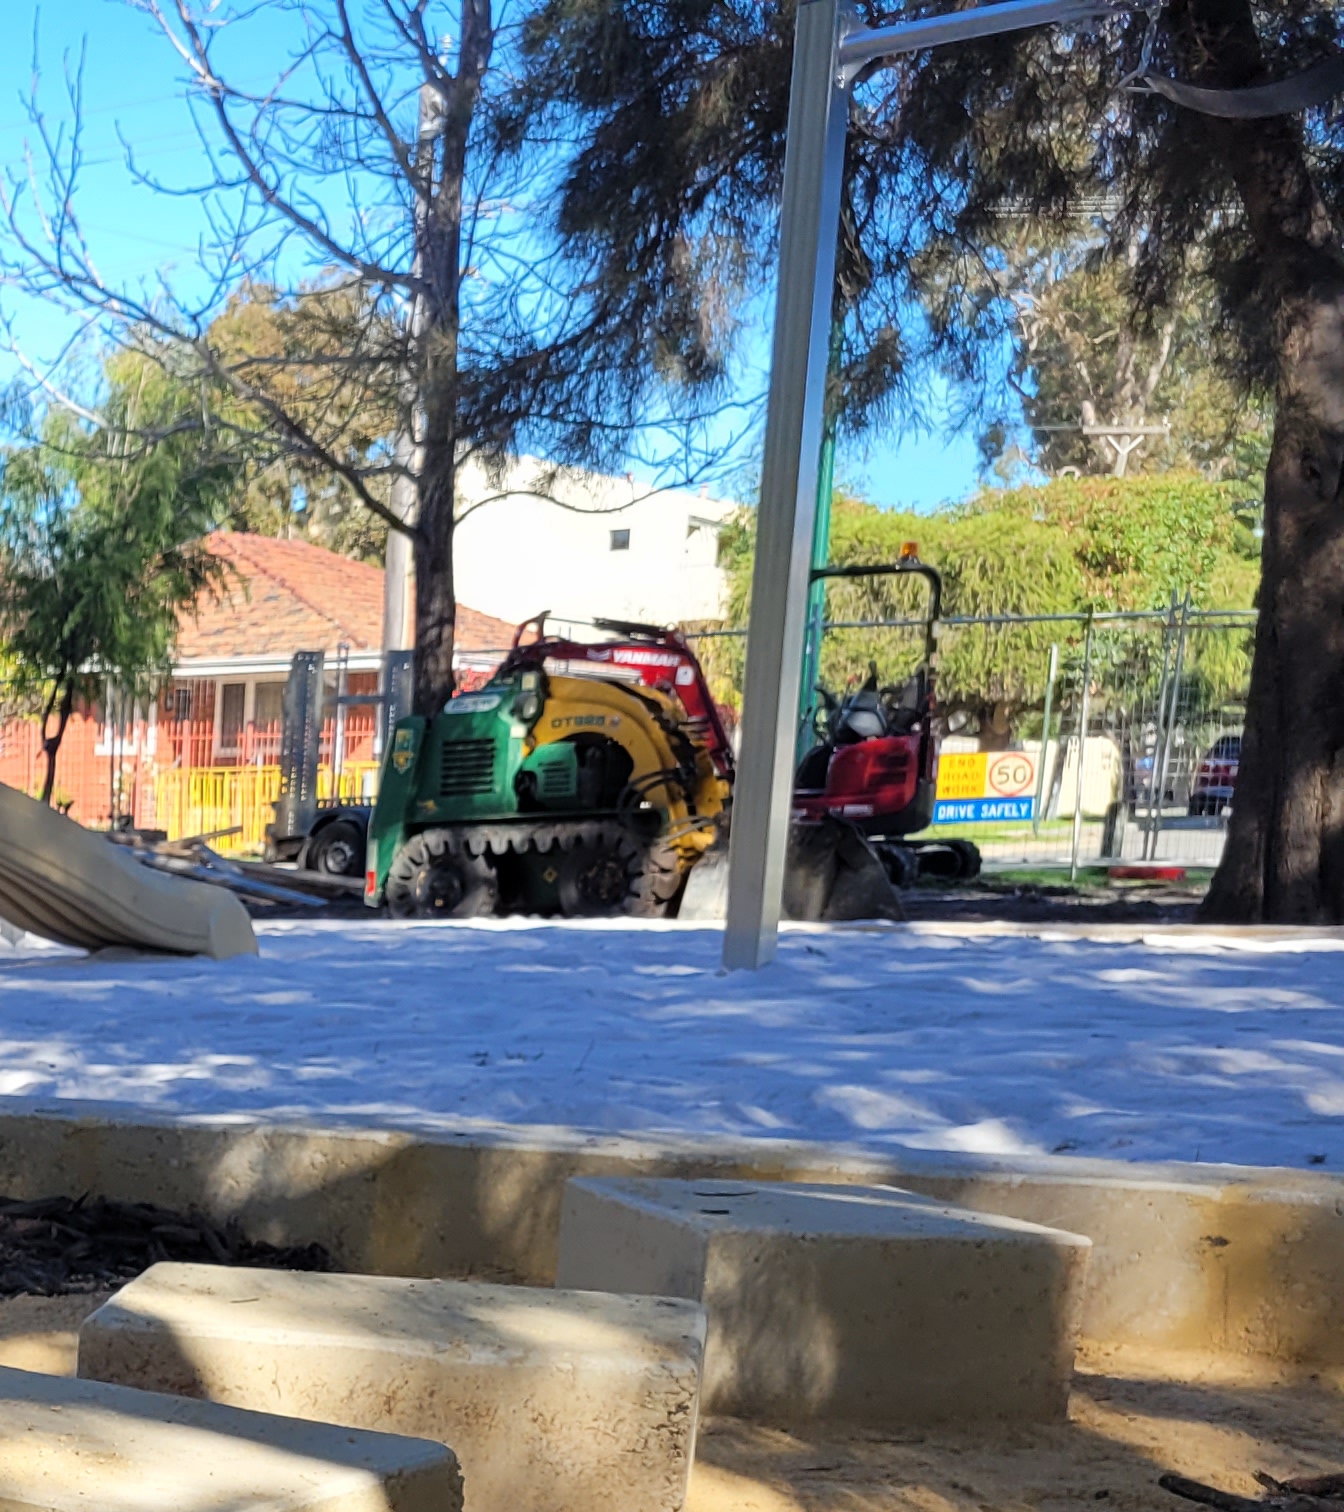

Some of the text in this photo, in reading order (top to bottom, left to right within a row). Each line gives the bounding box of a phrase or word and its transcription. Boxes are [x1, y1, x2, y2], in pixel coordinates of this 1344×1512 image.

[613, 650, 681, 666] YANMAR
[949, 757, 976, 768] END
[943, 772, 979, 781] ROAD
[997, 765, 1027, 785] 50
[942, 785, 977, 795] WORK
[937, 803, 1029, 820] DRIVE SAFELY
